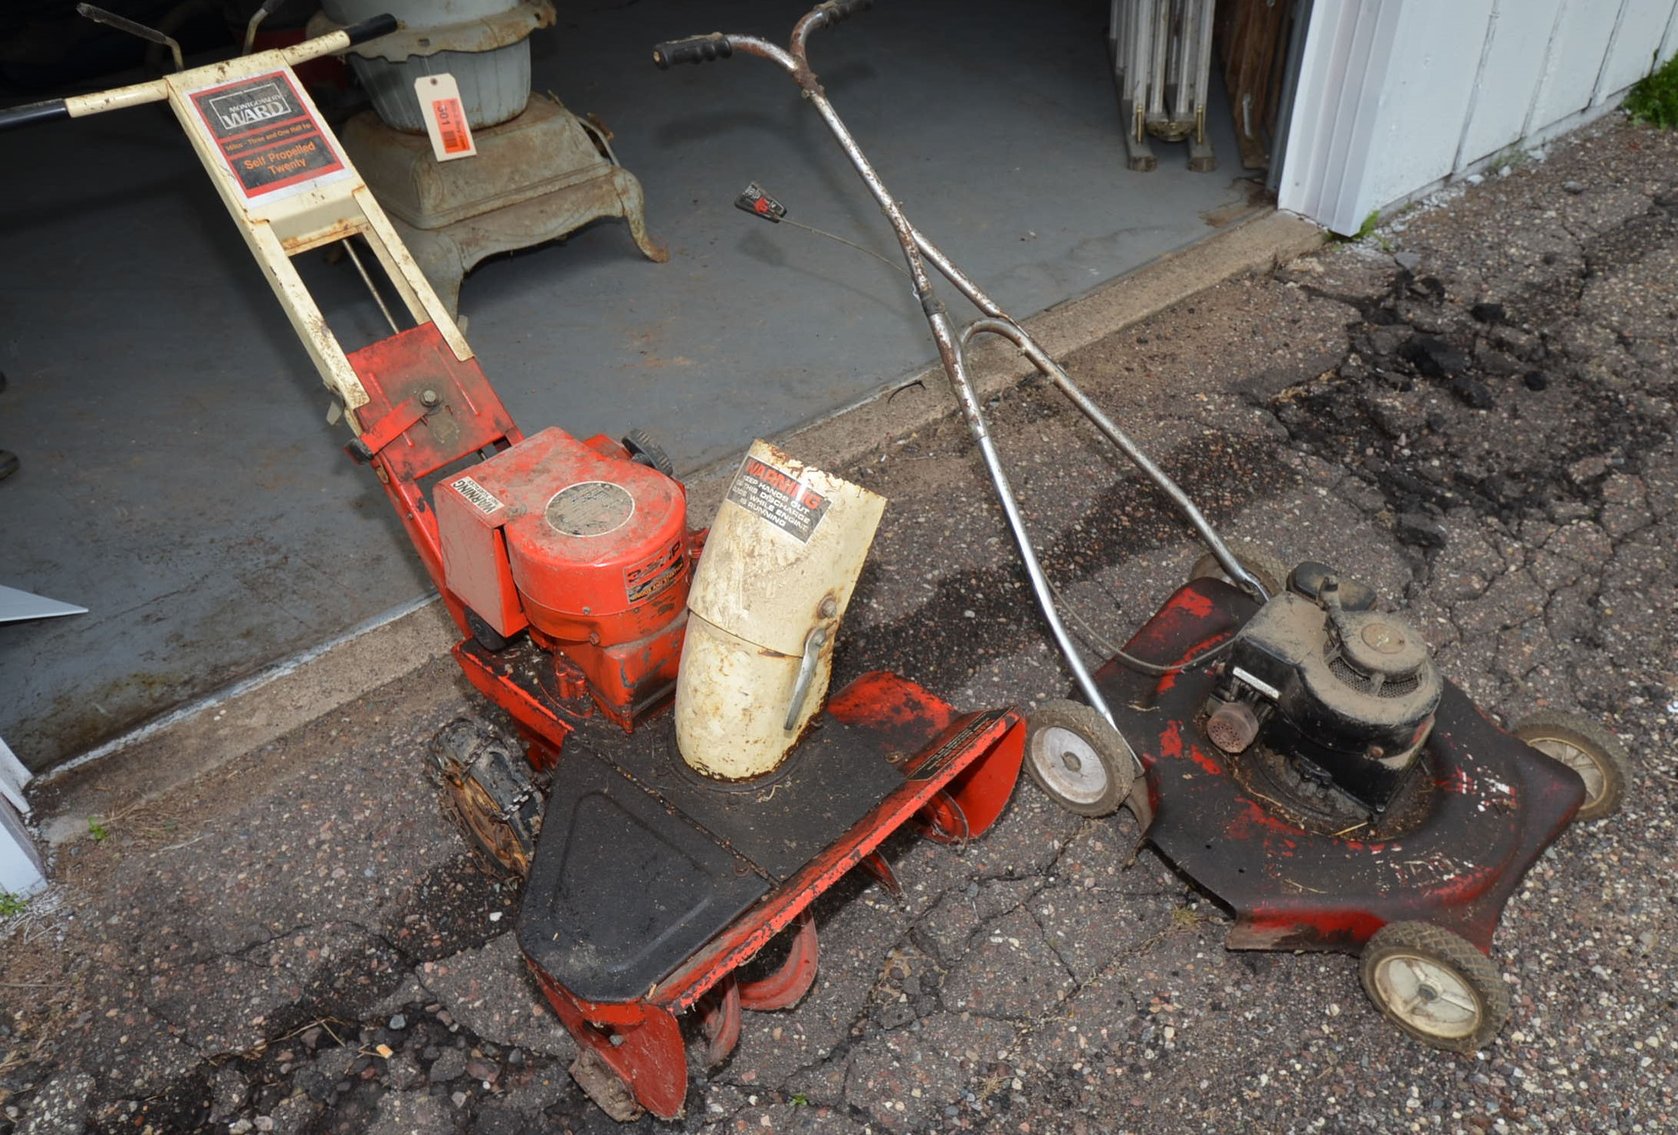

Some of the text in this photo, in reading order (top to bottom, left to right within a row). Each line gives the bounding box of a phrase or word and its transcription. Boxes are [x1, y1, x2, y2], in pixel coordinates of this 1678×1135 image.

[222, 102, 284, 127] WARD
[229, 94, 282, 113] MONTGOMERY
[244, 141, 316, 171] Self Propelled
[268, 158, 306, 175] Twenty
[453, 480, 496, 513] WARNING
[749, 493, 775, 512] WHILE
[758, 481, 789, 502] HANDS
[790, 499, 811, 515] OUT
[759, 490, 811, 524] DISCHARGE
[747, 500, 786, 527] RUNNING
